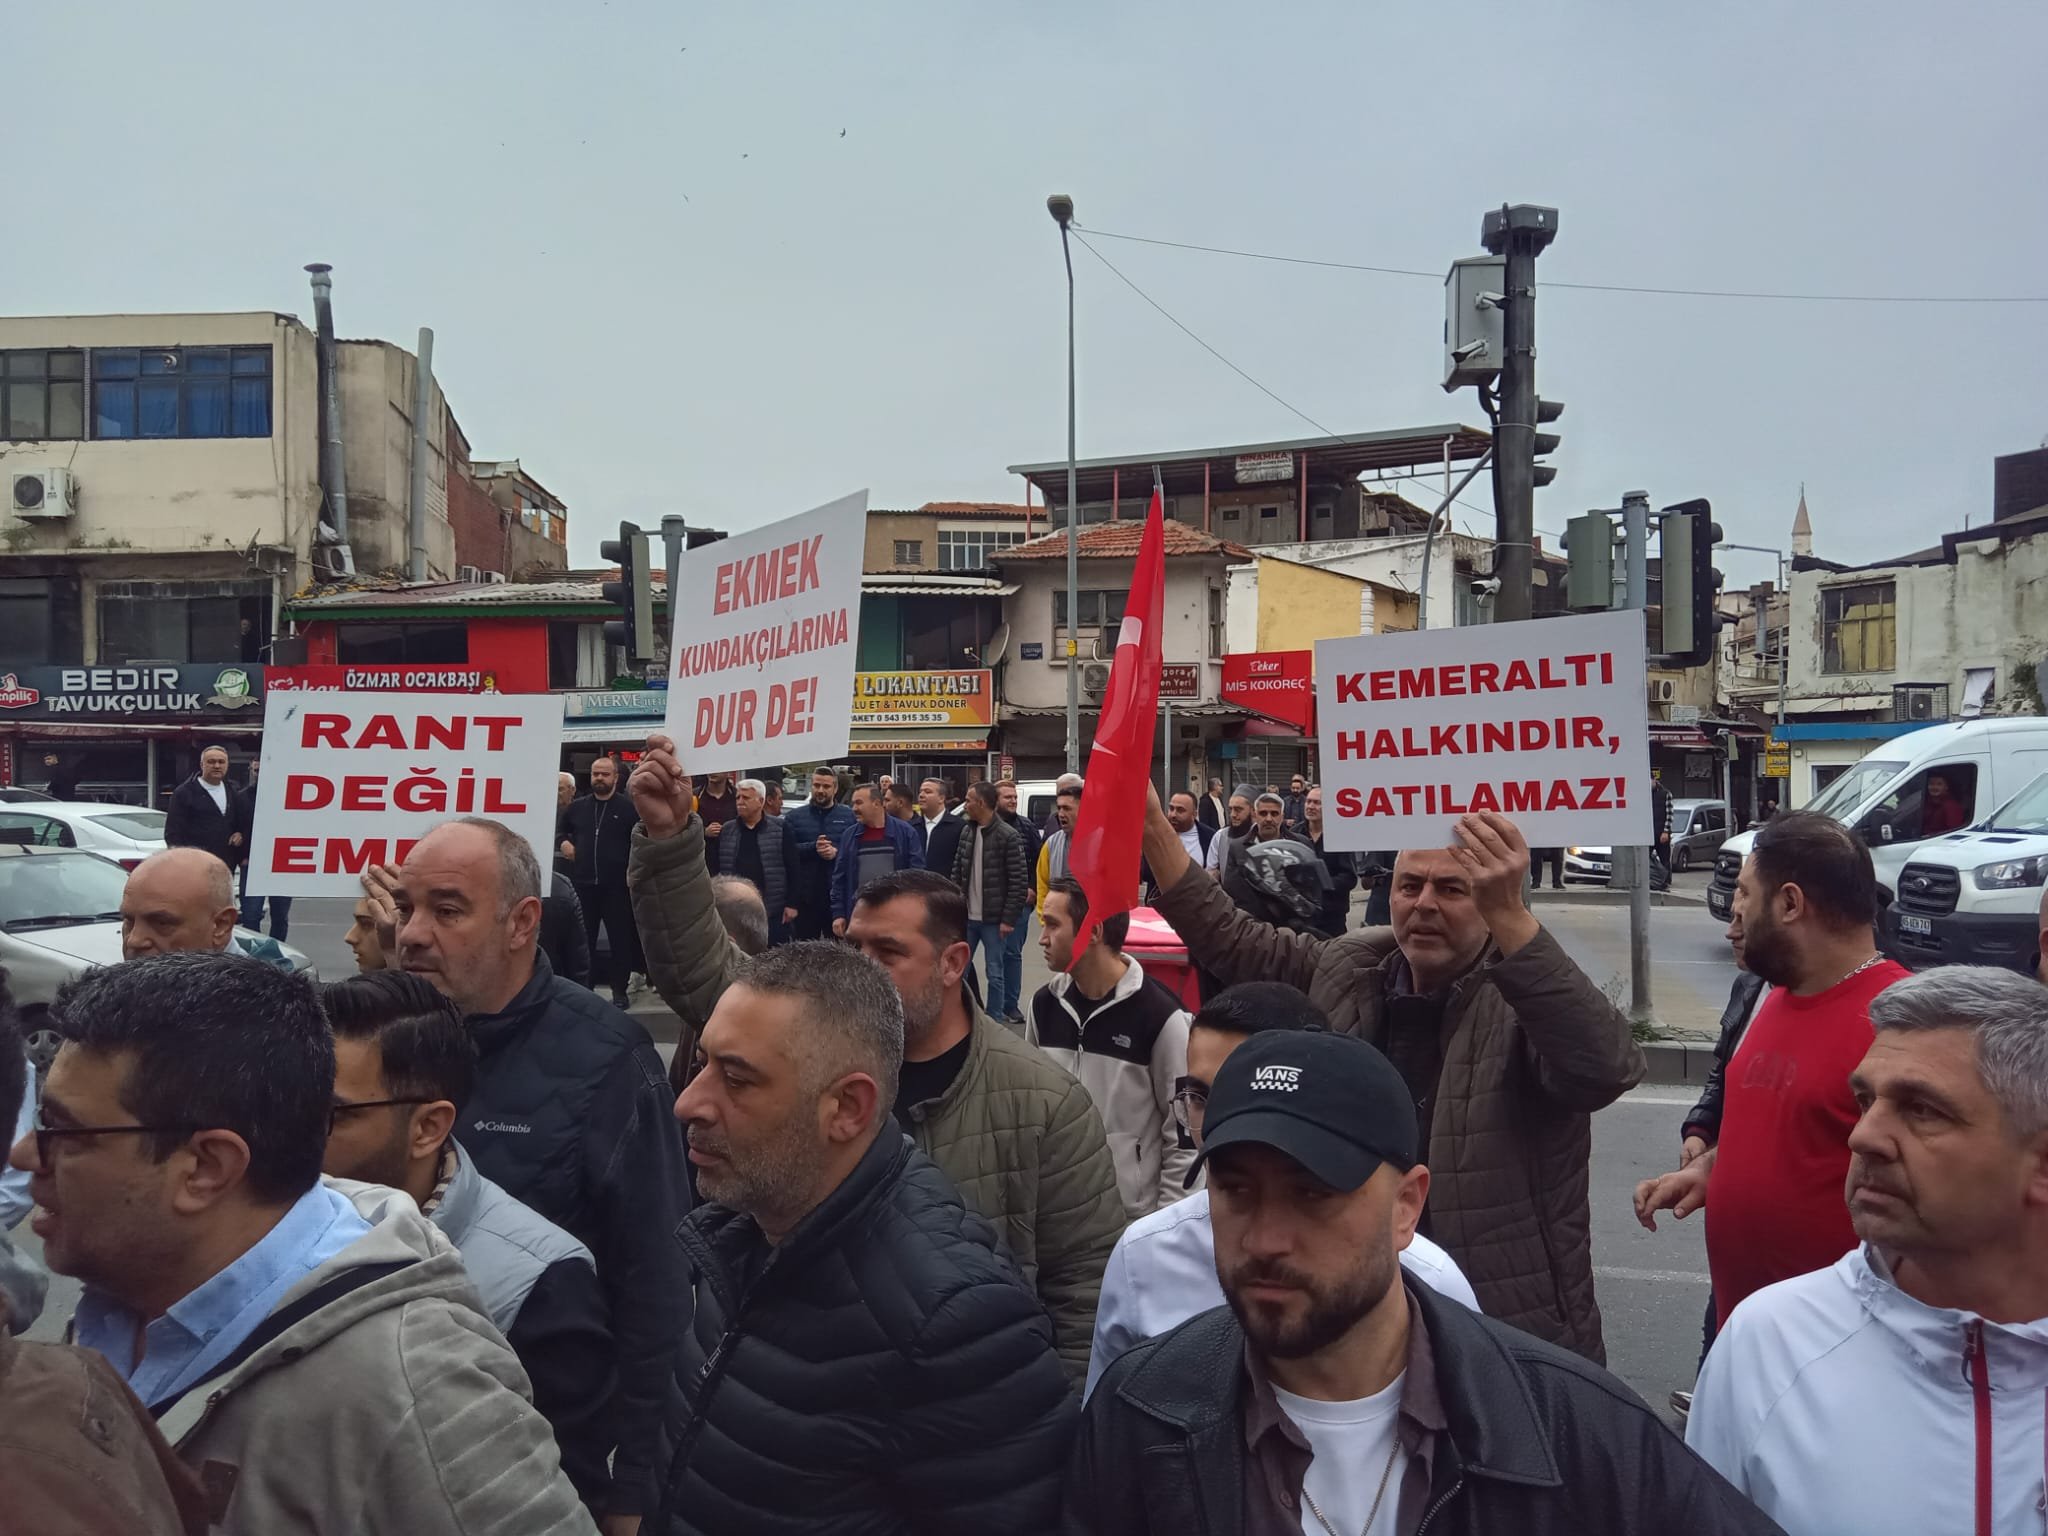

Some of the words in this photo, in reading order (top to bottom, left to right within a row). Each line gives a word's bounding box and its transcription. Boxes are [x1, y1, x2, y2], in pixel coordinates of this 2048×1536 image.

[714, 534, 823, 616] EKMEK
[679, 608, 848, 678] KUNDAKÇILARINA
[346, 669, 401, 688] ÖZMAR
[405, 671, 480, 692] OCAKBAŞI
[1162, 669, 1185, 677] gora
[1336, 653, 1613, 703] KEMERALTI
[863, 675, 980, 695] LOKANTASI
[1226, 680, 1247, 691] MİS
[1250, 678, 1305, 691] KOKOREÇ
[44, 694, 201, 715] TAVUKÇULUK
[588, 695, 640, 707] MERVE
[694, 689, 757, 748] DUR
[765, 676, 818, 738] DE!
[869, 700, 880, 709] ET
[884, 700, 891, 709] &
[894, 700, 926, 709] TAVUK
[930, 698, 967, 708] DÖNER
[851, 714, 874, 722] AKET
[301, 713, 523, 751] RANT
[1337, 716, 1620, 760] HALKINDIR,
[284, 767, 526, 813] DEĞİL
[1336, 777, 1627, 818] SATILAMAZ!
[1256, 1065, 1303, 1082] VANS
[485, 1120, 531, 1134] Columbia
